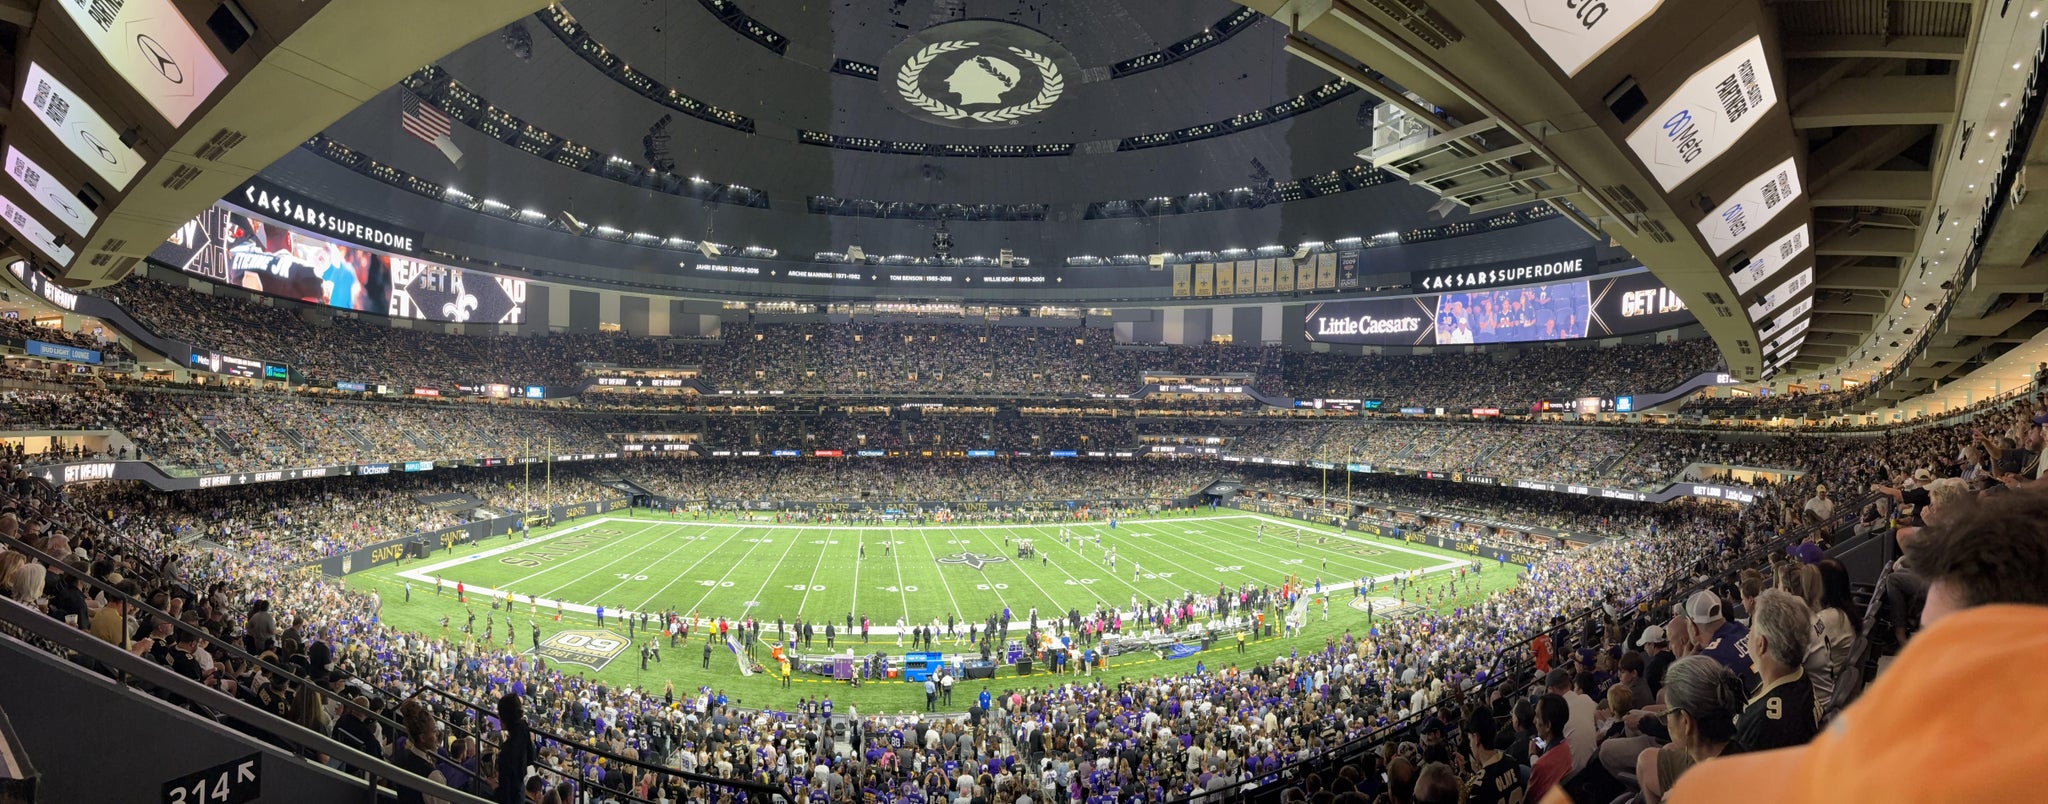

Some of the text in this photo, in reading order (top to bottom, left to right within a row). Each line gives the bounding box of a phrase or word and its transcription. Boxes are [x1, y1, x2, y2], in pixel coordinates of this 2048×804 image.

[1715, 73, 1748, 123] PARTNERS
[1673, 123, 1703, 164] Meta
[245, 185, 413, 252] CAESARS SUPERDOME
[711, 264, 728, 272] EVANS
[807, 271, 833, 279] MANNING
[835, 272, 861, 280] 1971-1982
[1422, 258, 1583, 290] CAESARS SUPERDOME
[1621, 288, 1657, 318] GET
[1318, 315, 1421, 335] Little Caesars
[72, 350, 90, 360] LOUNGE
[1717, 374, 1729, 384] GET
[64, 463, 116, 482] GET READY
[363, 464, 389, 475] Ochsner
[199, 477, 211, 487] GET
[255, 473, 265, 482] GET
[1466, 475, 1492, 484] CAESARS
[1693, 486, 1706, 495] GET
[610, 501, 628, 510] SAINTS
[565, 506, 586, 518] SAINTS
[1404, 532, 1426, 543] SAINTS
[371, 543, 403, 564] SAINTS
[499, 528, 625, 569] SAINTS
[792, 584, 826, 592] 30
[886, 584, 919, 593] 40
[556, 634, 622, 652] 60
[1766, 696, 1783, 720] 9
[169, 771, 230, 804] 314
